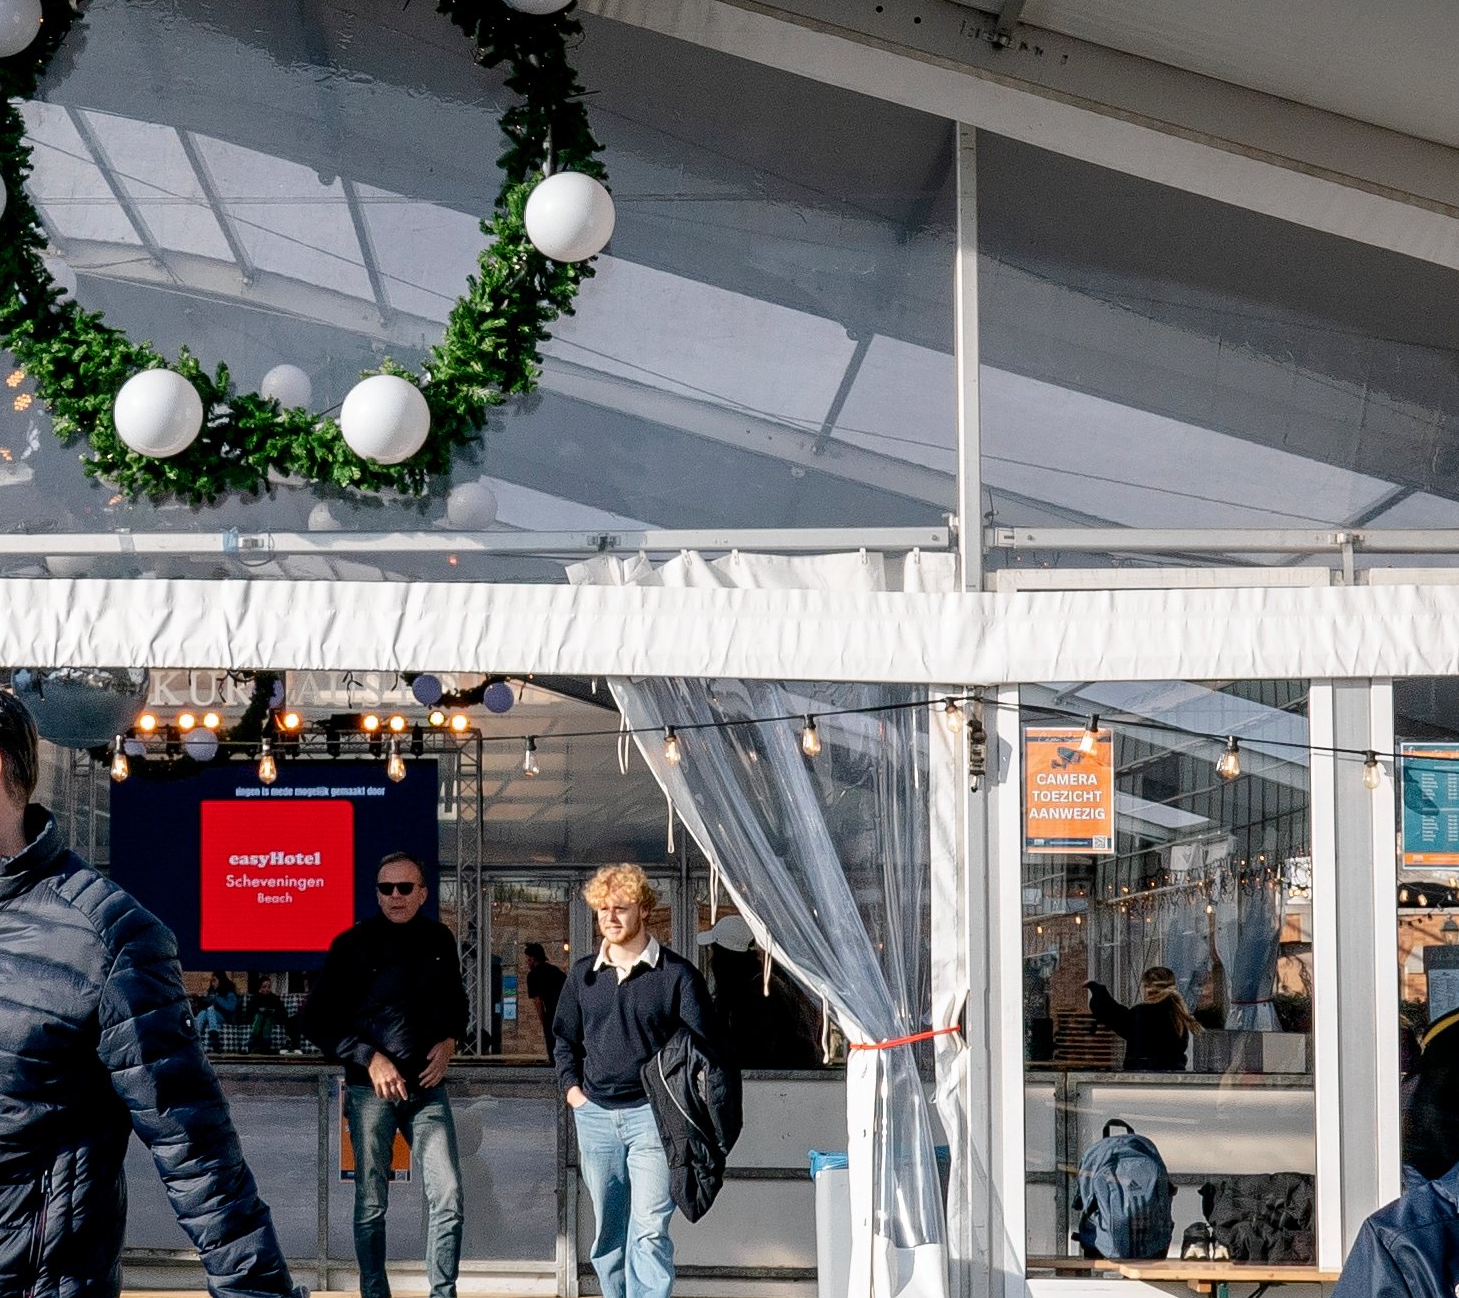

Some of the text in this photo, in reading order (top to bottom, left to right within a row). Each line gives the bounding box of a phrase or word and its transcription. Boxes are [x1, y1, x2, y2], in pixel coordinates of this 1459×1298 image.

[1036, 773, 1098, 785] CAMERA
[1032, 790, 1103, 802] TOEZICHT
[1029, 807, 1106, 819] AANWEZIG
[228, 851, 321, 868] easyHotel
[225, 874, 324, 891] Scheveningen
[257, 891, 293, 903] Beach
